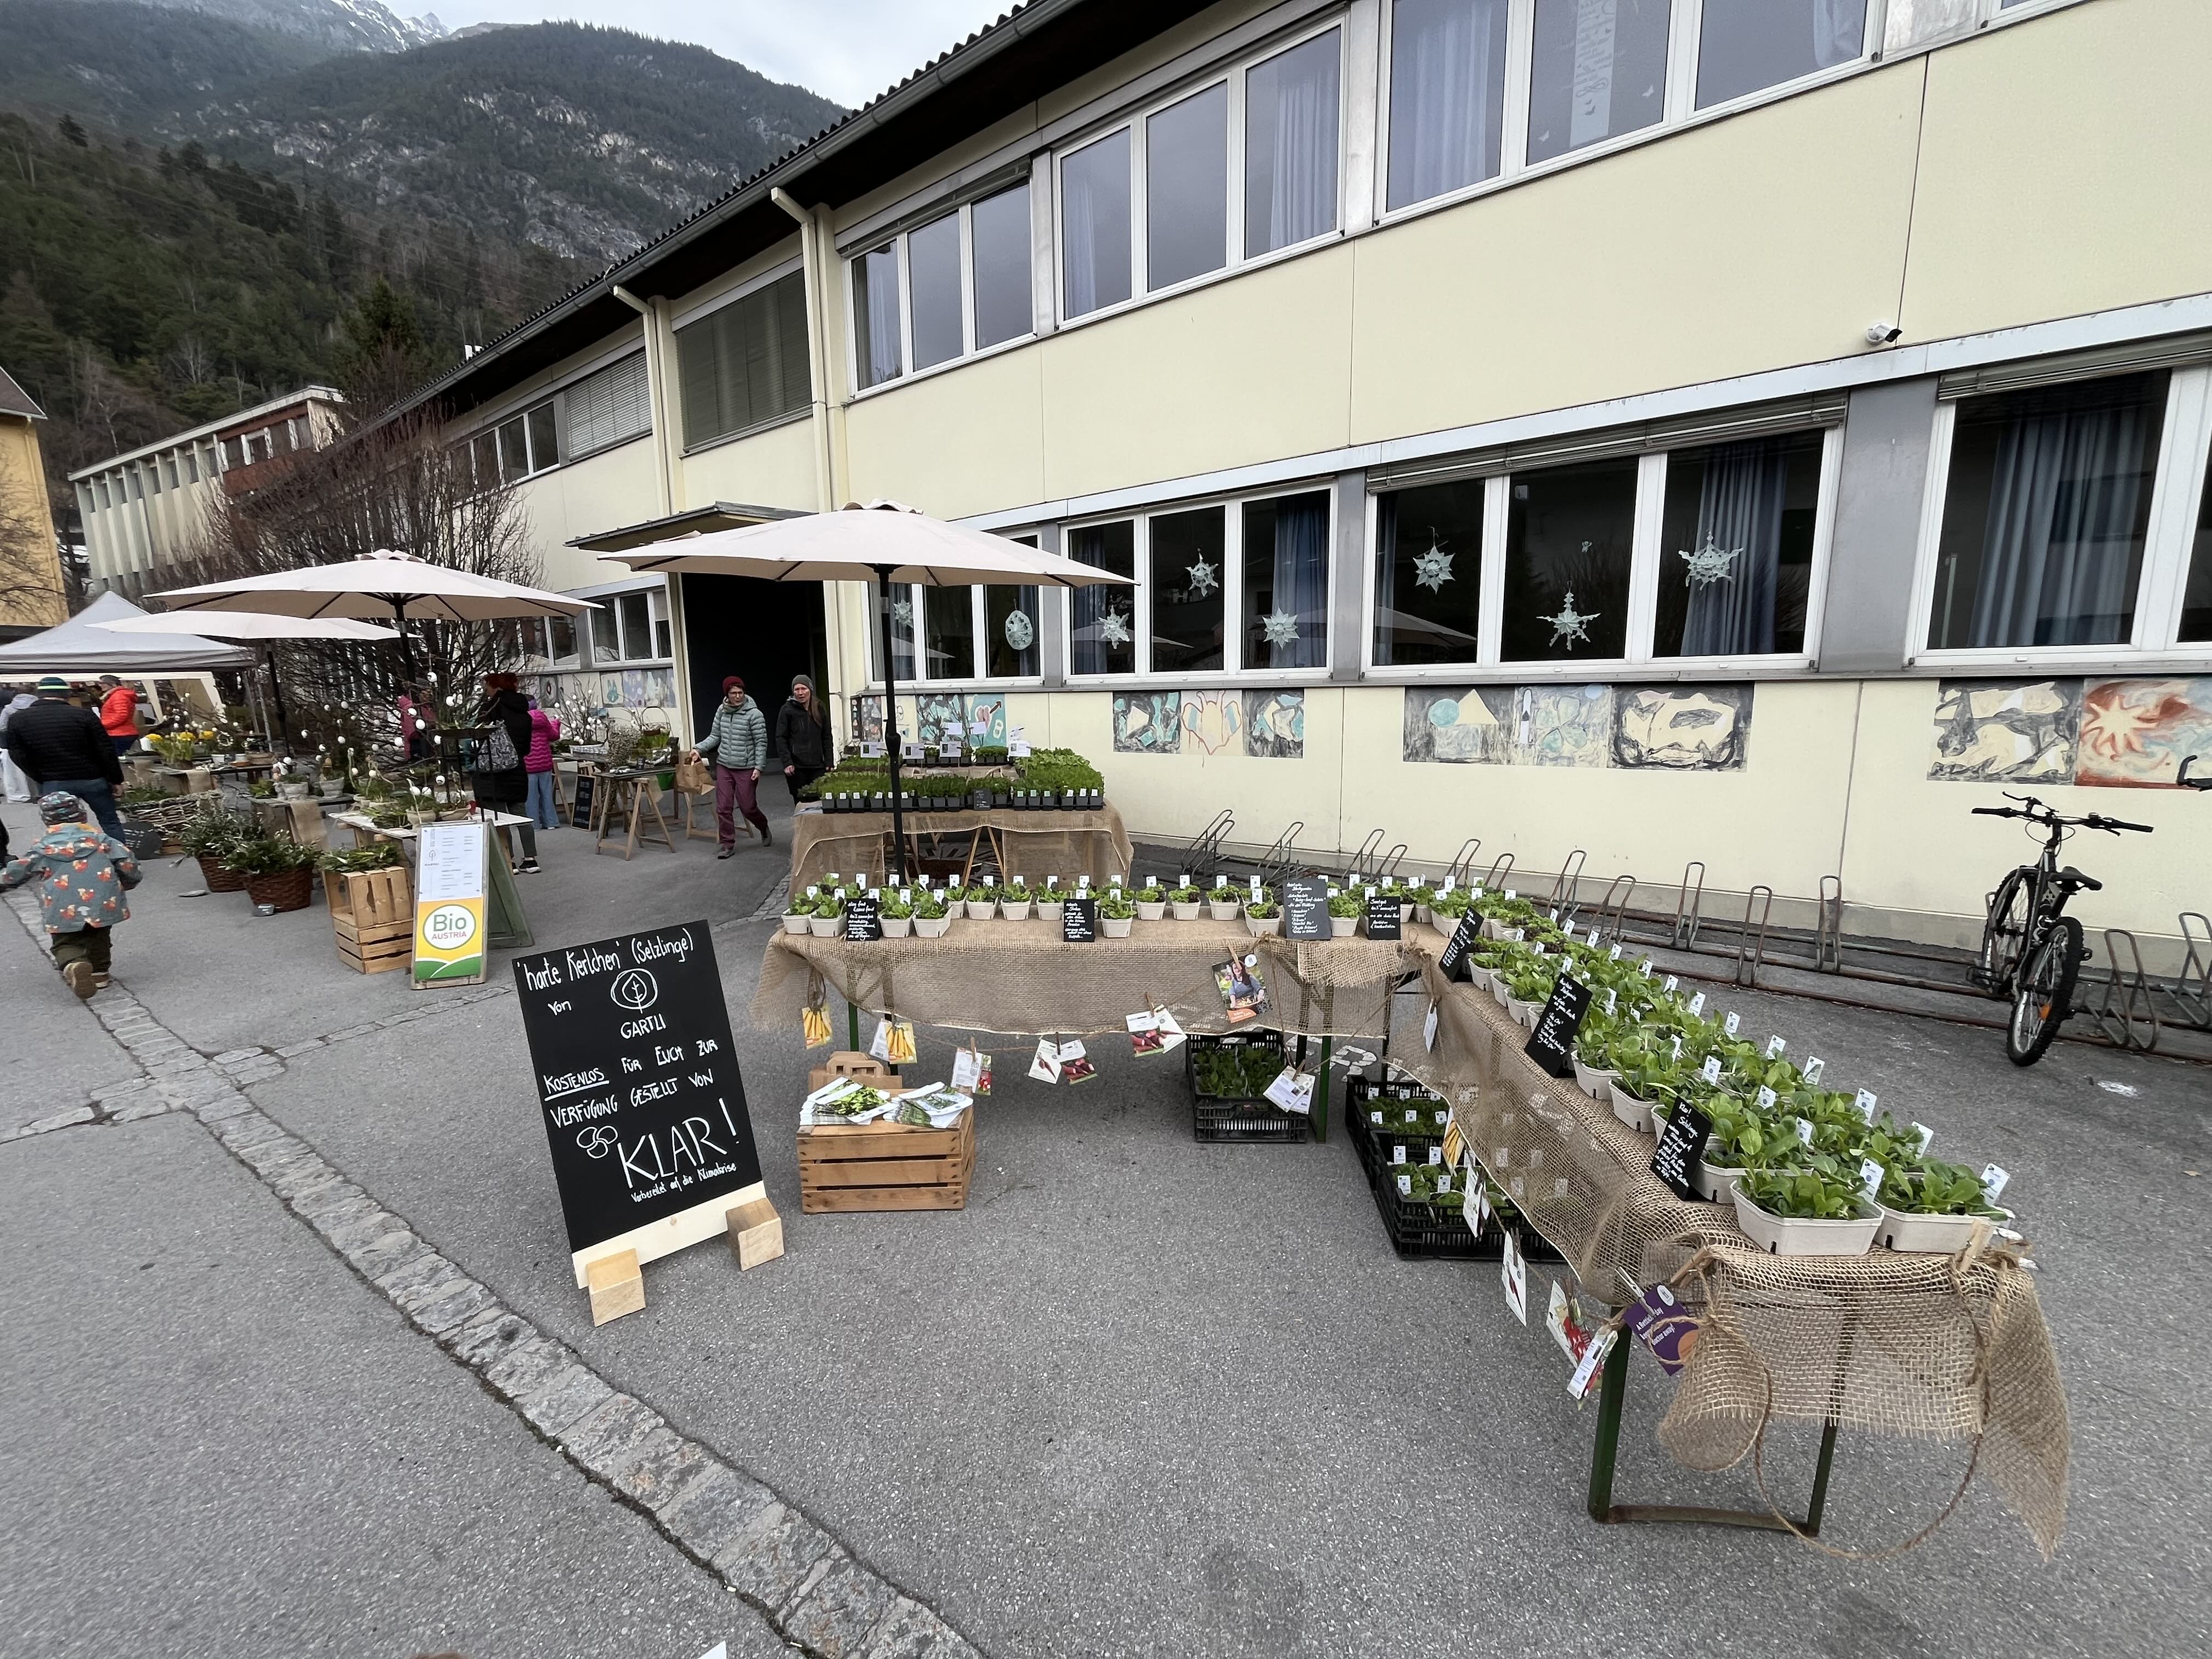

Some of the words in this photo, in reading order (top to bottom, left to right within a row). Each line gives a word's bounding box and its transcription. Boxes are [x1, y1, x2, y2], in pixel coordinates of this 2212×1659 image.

[432, 931, 467, 940] AUSTRIA
[433, 913, 466, 932] Bio
[620, 1013, 666, 1039] GARTLI
[543, 1068, 605, 1094] KOSTENLOS
[655, 1046, 684, 1066] EUCH
[696, 1039, 718, 1057] ZUR
[550, 1094, 618, 1128] VERFÜGUNG
[630, 1077, 678, 1107] GESTELLT
[688, 1068, 714, 1087] VON
[670, 1176, 682, 1192] auf
[682, 1175, 693, 1186] die
[697, 1162, 737, 1182] Klimakrise
